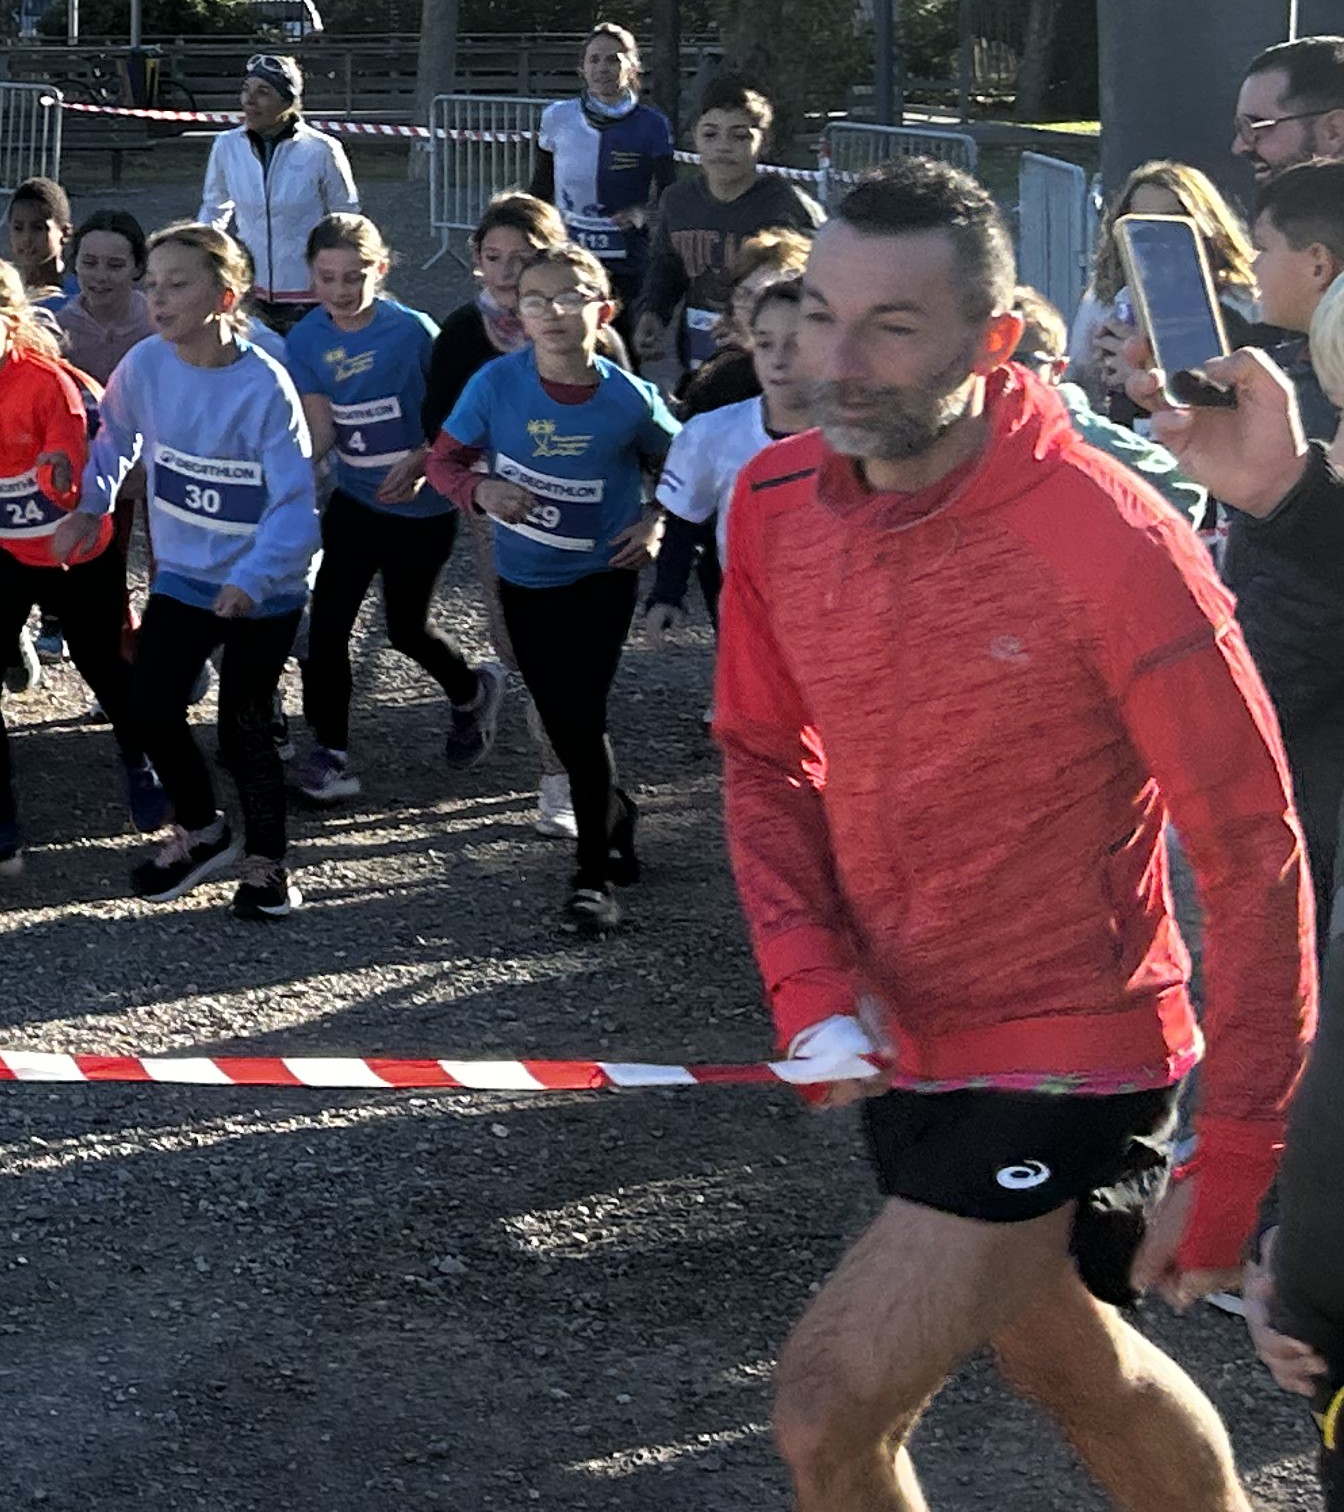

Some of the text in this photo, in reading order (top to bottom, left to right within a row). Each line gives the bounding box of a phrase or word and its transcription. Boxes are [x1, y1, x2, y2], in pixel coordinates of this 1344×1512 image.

[348, 430, 367, 453] 4
[519, 471, 597, 497] DECATHLON
[5, 499, 45, 524] 24
[184, 484, 221, 514] 30
